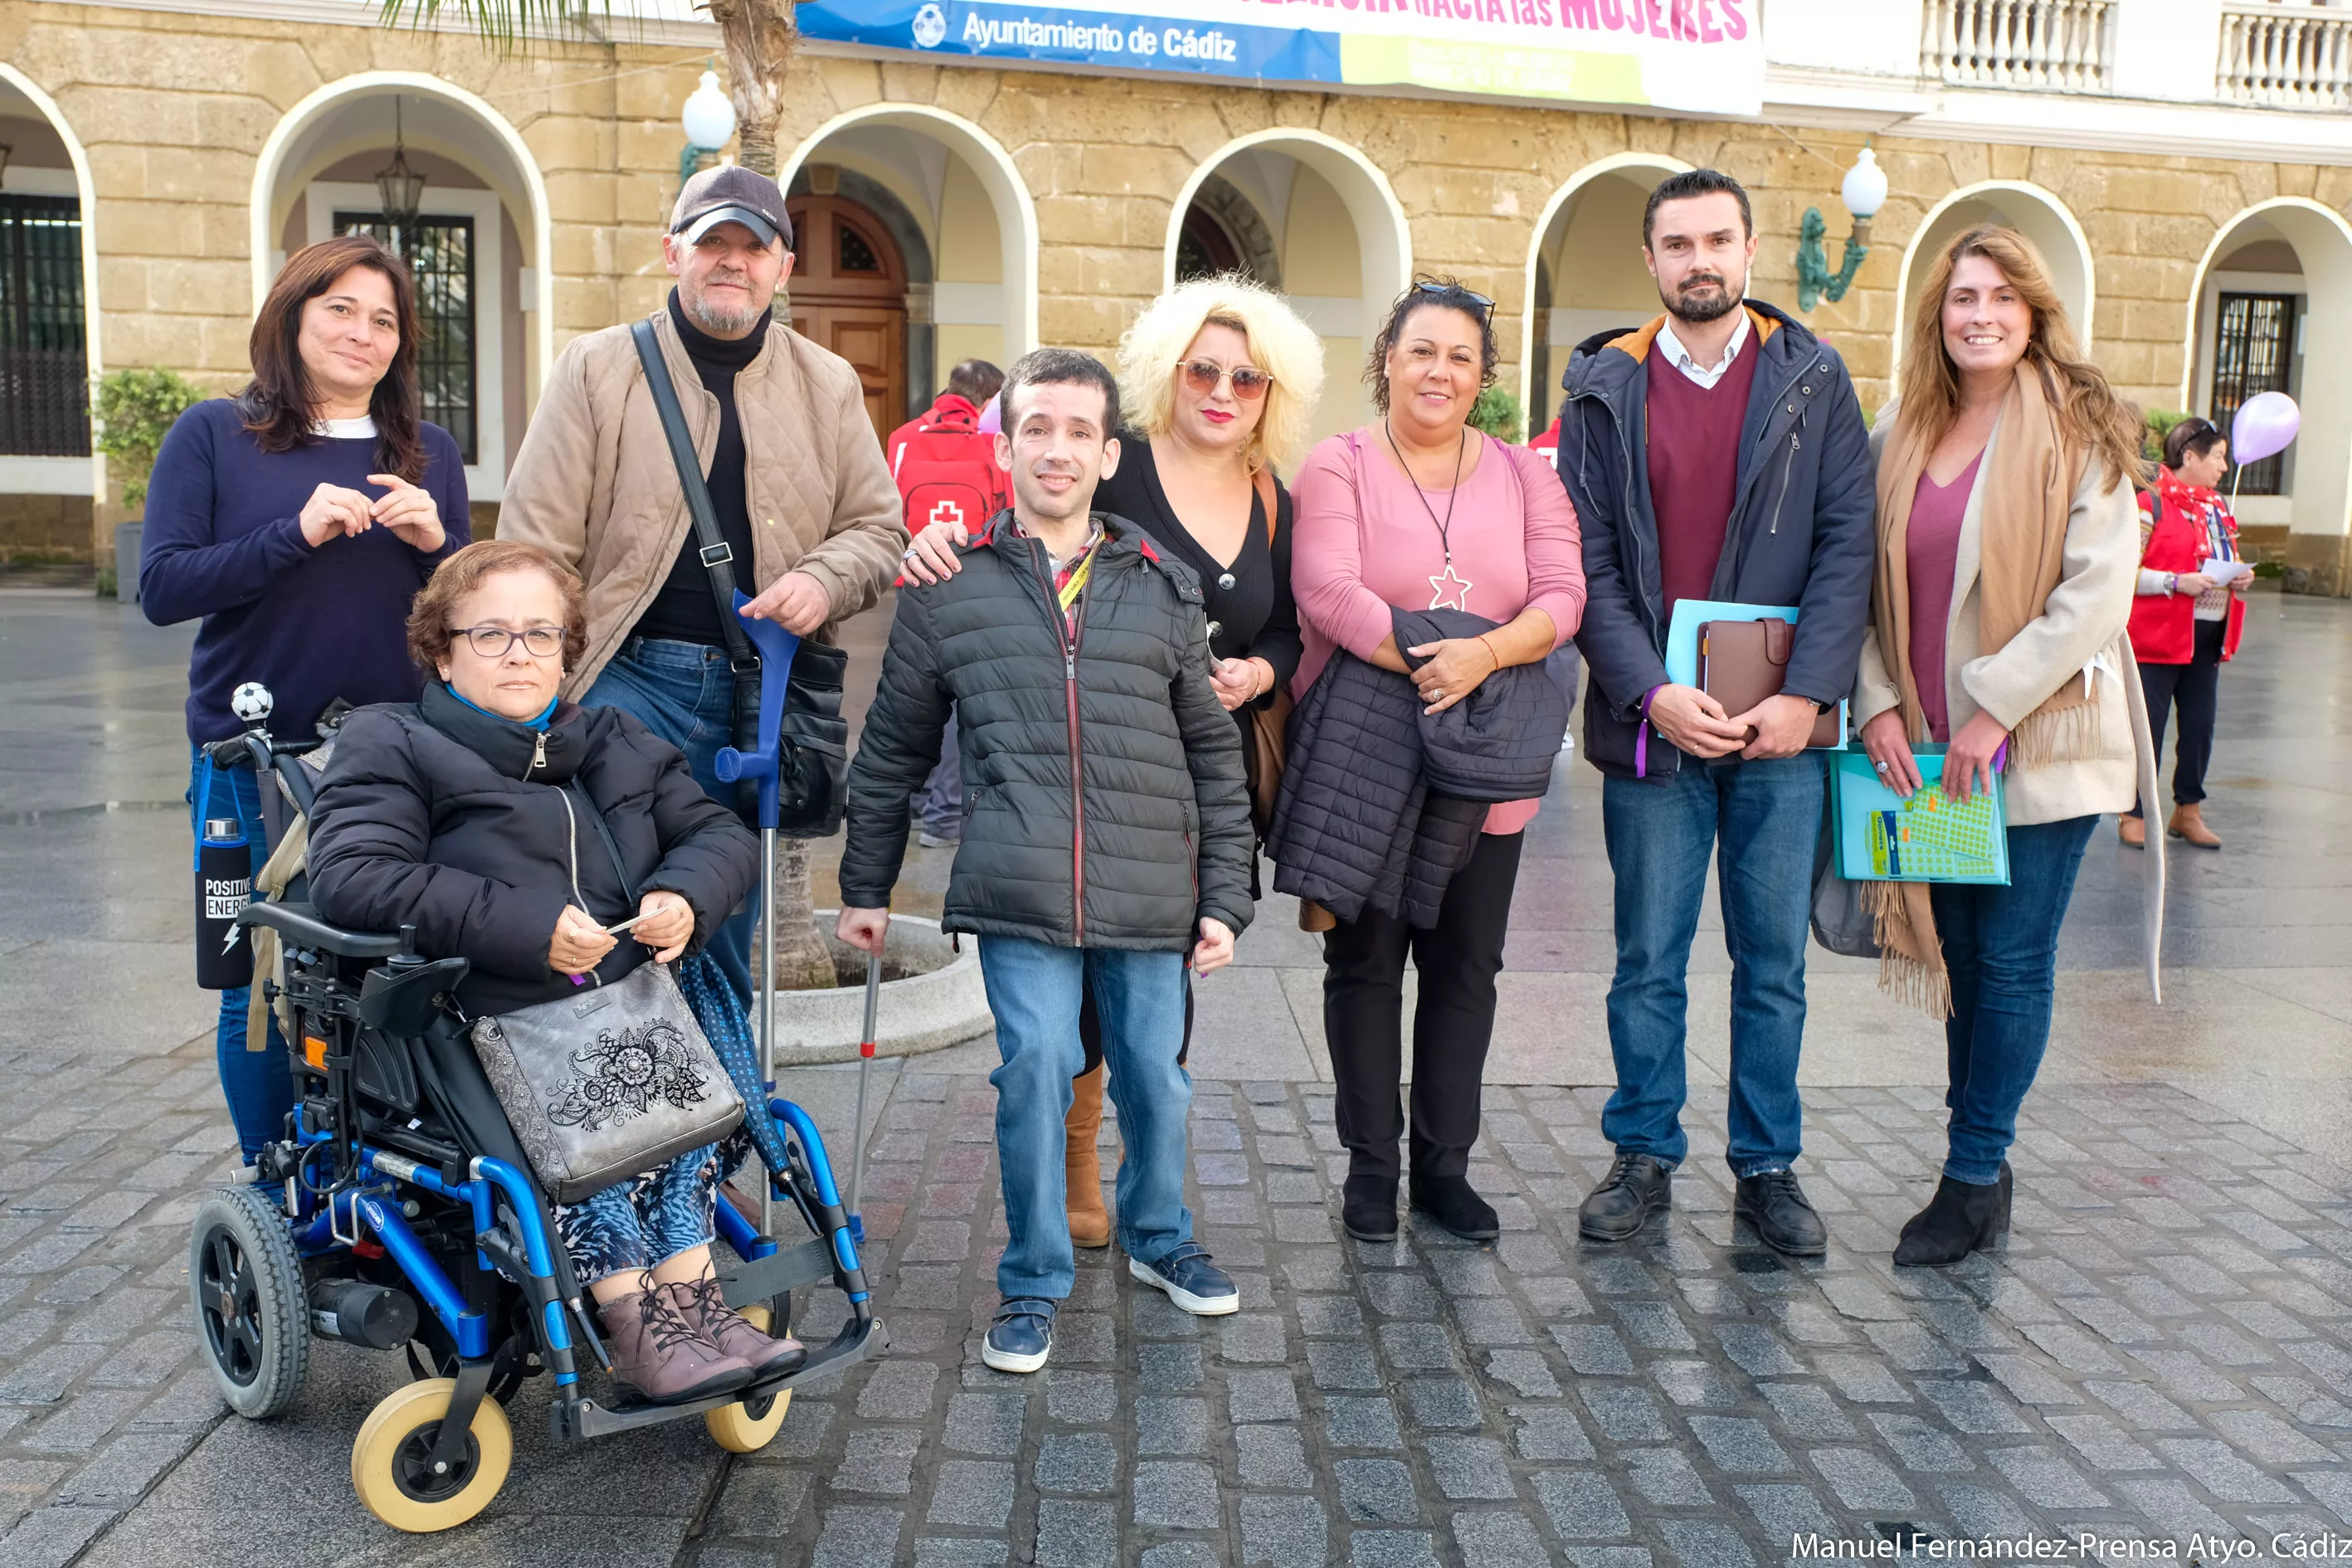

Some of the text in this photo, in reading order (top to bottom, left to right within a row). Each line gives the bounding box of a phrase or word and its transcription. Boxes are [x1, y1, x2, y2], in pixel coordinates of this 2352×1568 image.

[962, 12, 1236, 61] Ayuntamiento de Cádiz
[206, 877, 251, 896] POSITIVE
